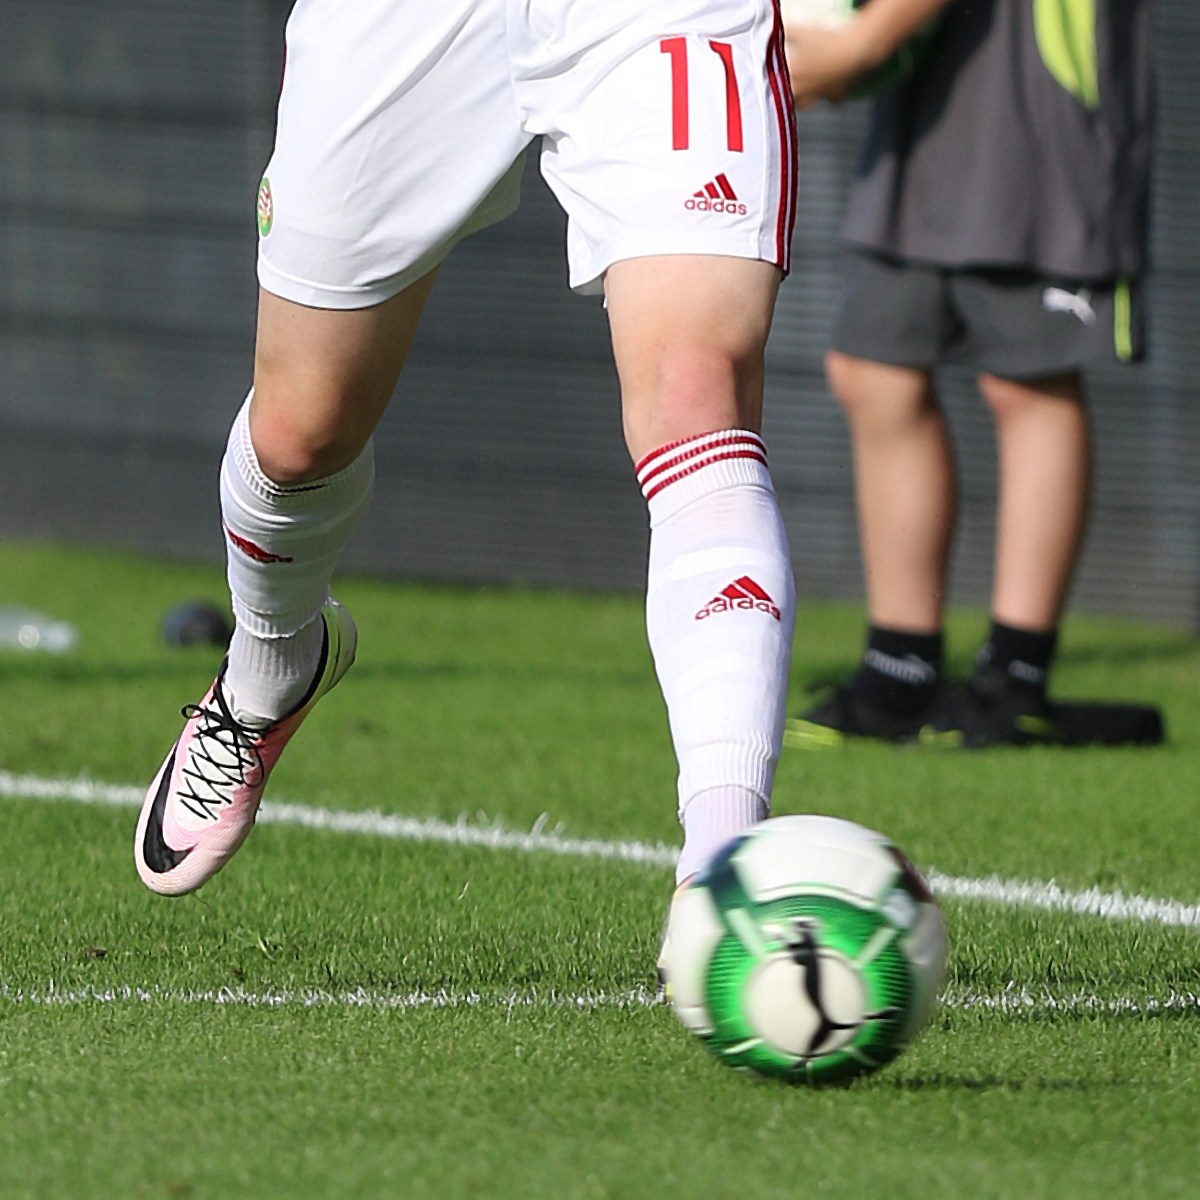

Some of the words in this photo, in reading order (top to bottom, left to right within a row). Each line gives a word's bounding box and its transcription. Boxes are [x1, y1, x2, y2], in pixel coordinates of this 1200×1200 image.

[660, 37, 744, 153] 11
[684, 198, 748, 216] adidas
[695, 597, 781, 621] adidas
